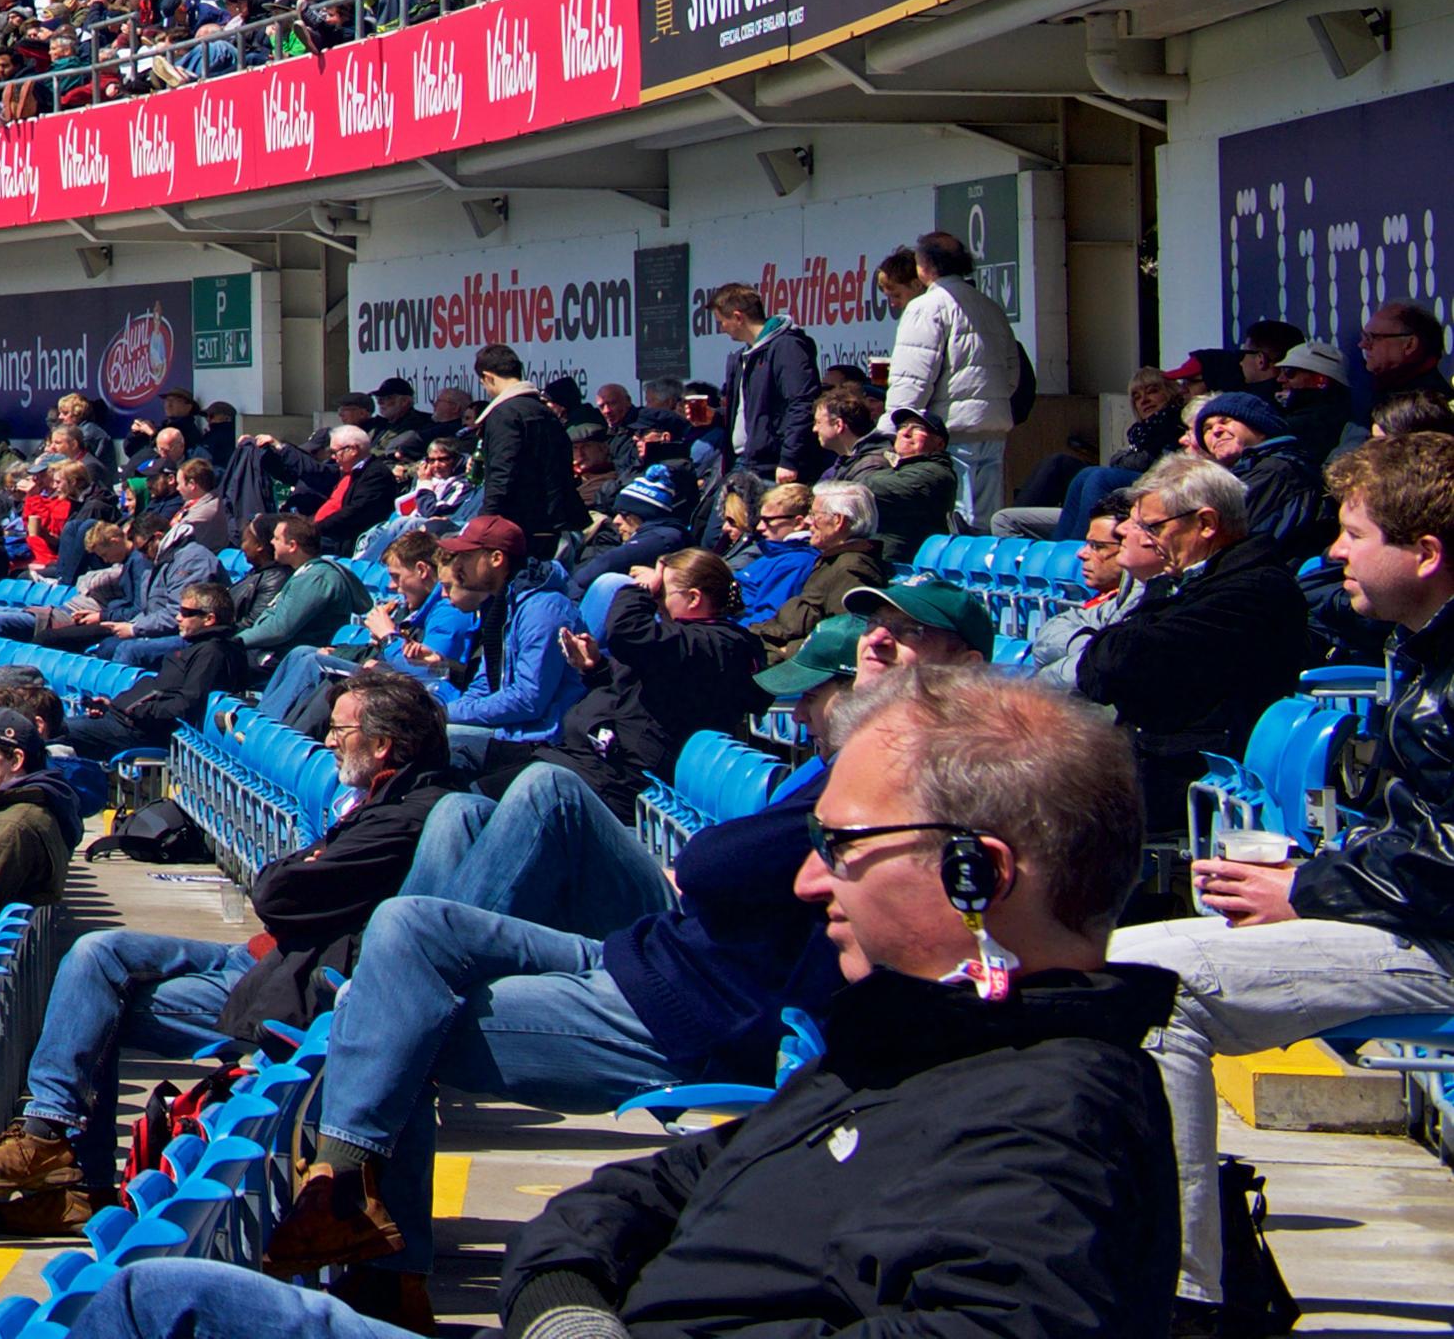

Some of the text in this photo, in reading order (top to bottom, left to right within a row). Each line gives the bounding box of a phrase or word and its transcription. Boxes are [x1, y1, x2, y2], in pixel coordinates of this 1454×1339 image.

[337, 51, 395, 156] Vitality
[413, 30, 463, 141] Vitality
[487, 8, 537, 123] Vitality
[59, 119, 109, 207] Vitality
[129, 105, 175, 196] Vitality
[194, 89, 243, 185] Vitality
[263, 71, 315, 172] Vitality
[968, 204, 985, 261] Q
[197, 336, 218, 359] EXIT
[216, 293, 227, 326] P
[358, 269, 632, 354] arrowselfdrive.com
[37, 333, 88, 391] hand
